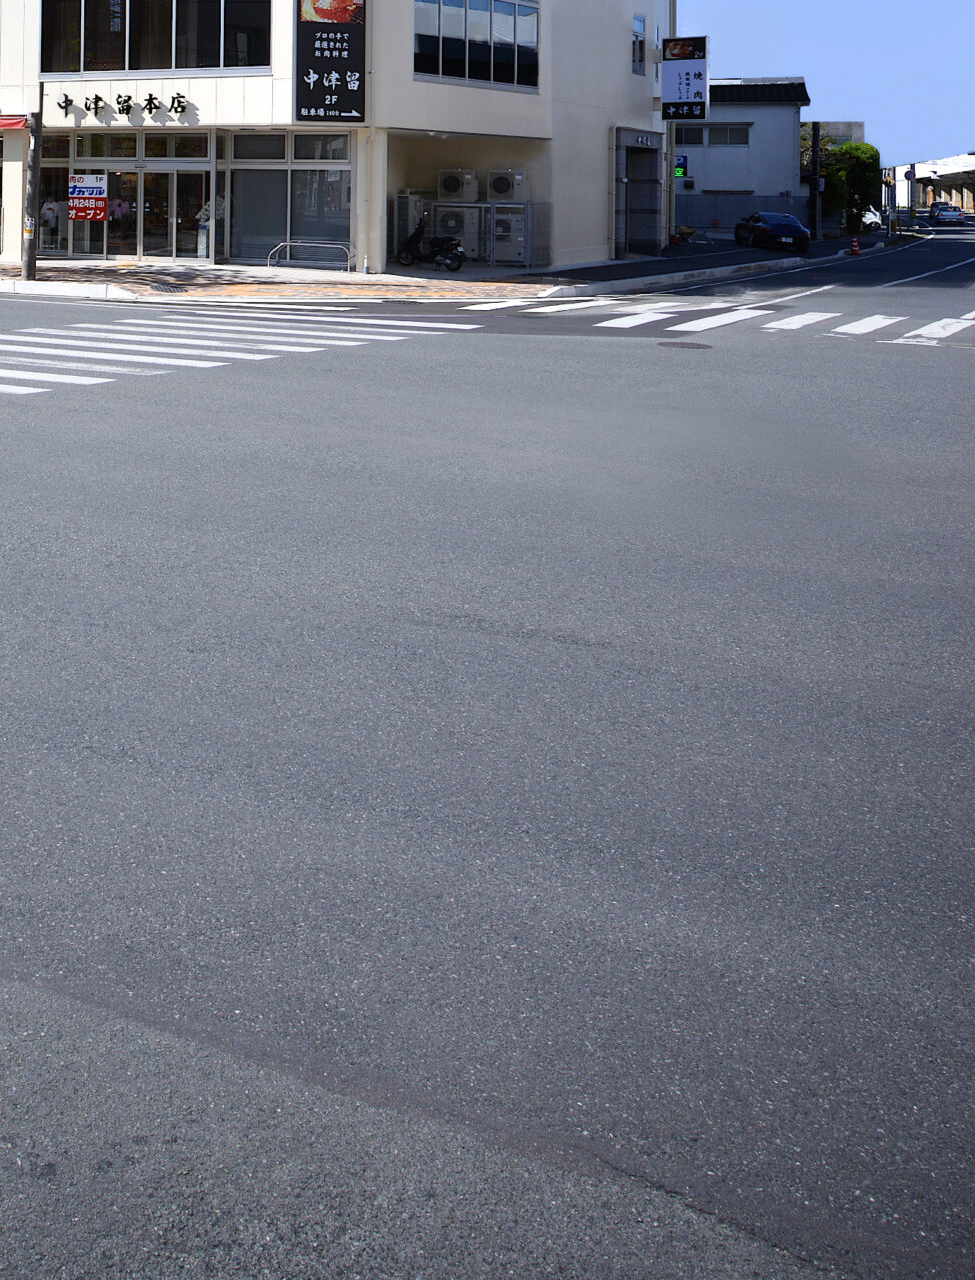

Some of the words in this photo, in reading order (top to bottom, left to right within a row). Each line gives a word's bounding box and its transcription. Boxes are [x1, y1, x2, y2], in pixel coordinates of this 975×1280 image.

[315, 32, 349, 40] プロの手で
[315, 50, 349, 58] お肉料理
[303, 68, 360, 91] 中津留
[325, 95, 338, 105] 2F
[57, 93, 187, 118] 中津留本店
[667, 105, 701, 116] 中津留
[301, 108, 325, 116] 駐車場
[68, 209, 105, 219] オープン
